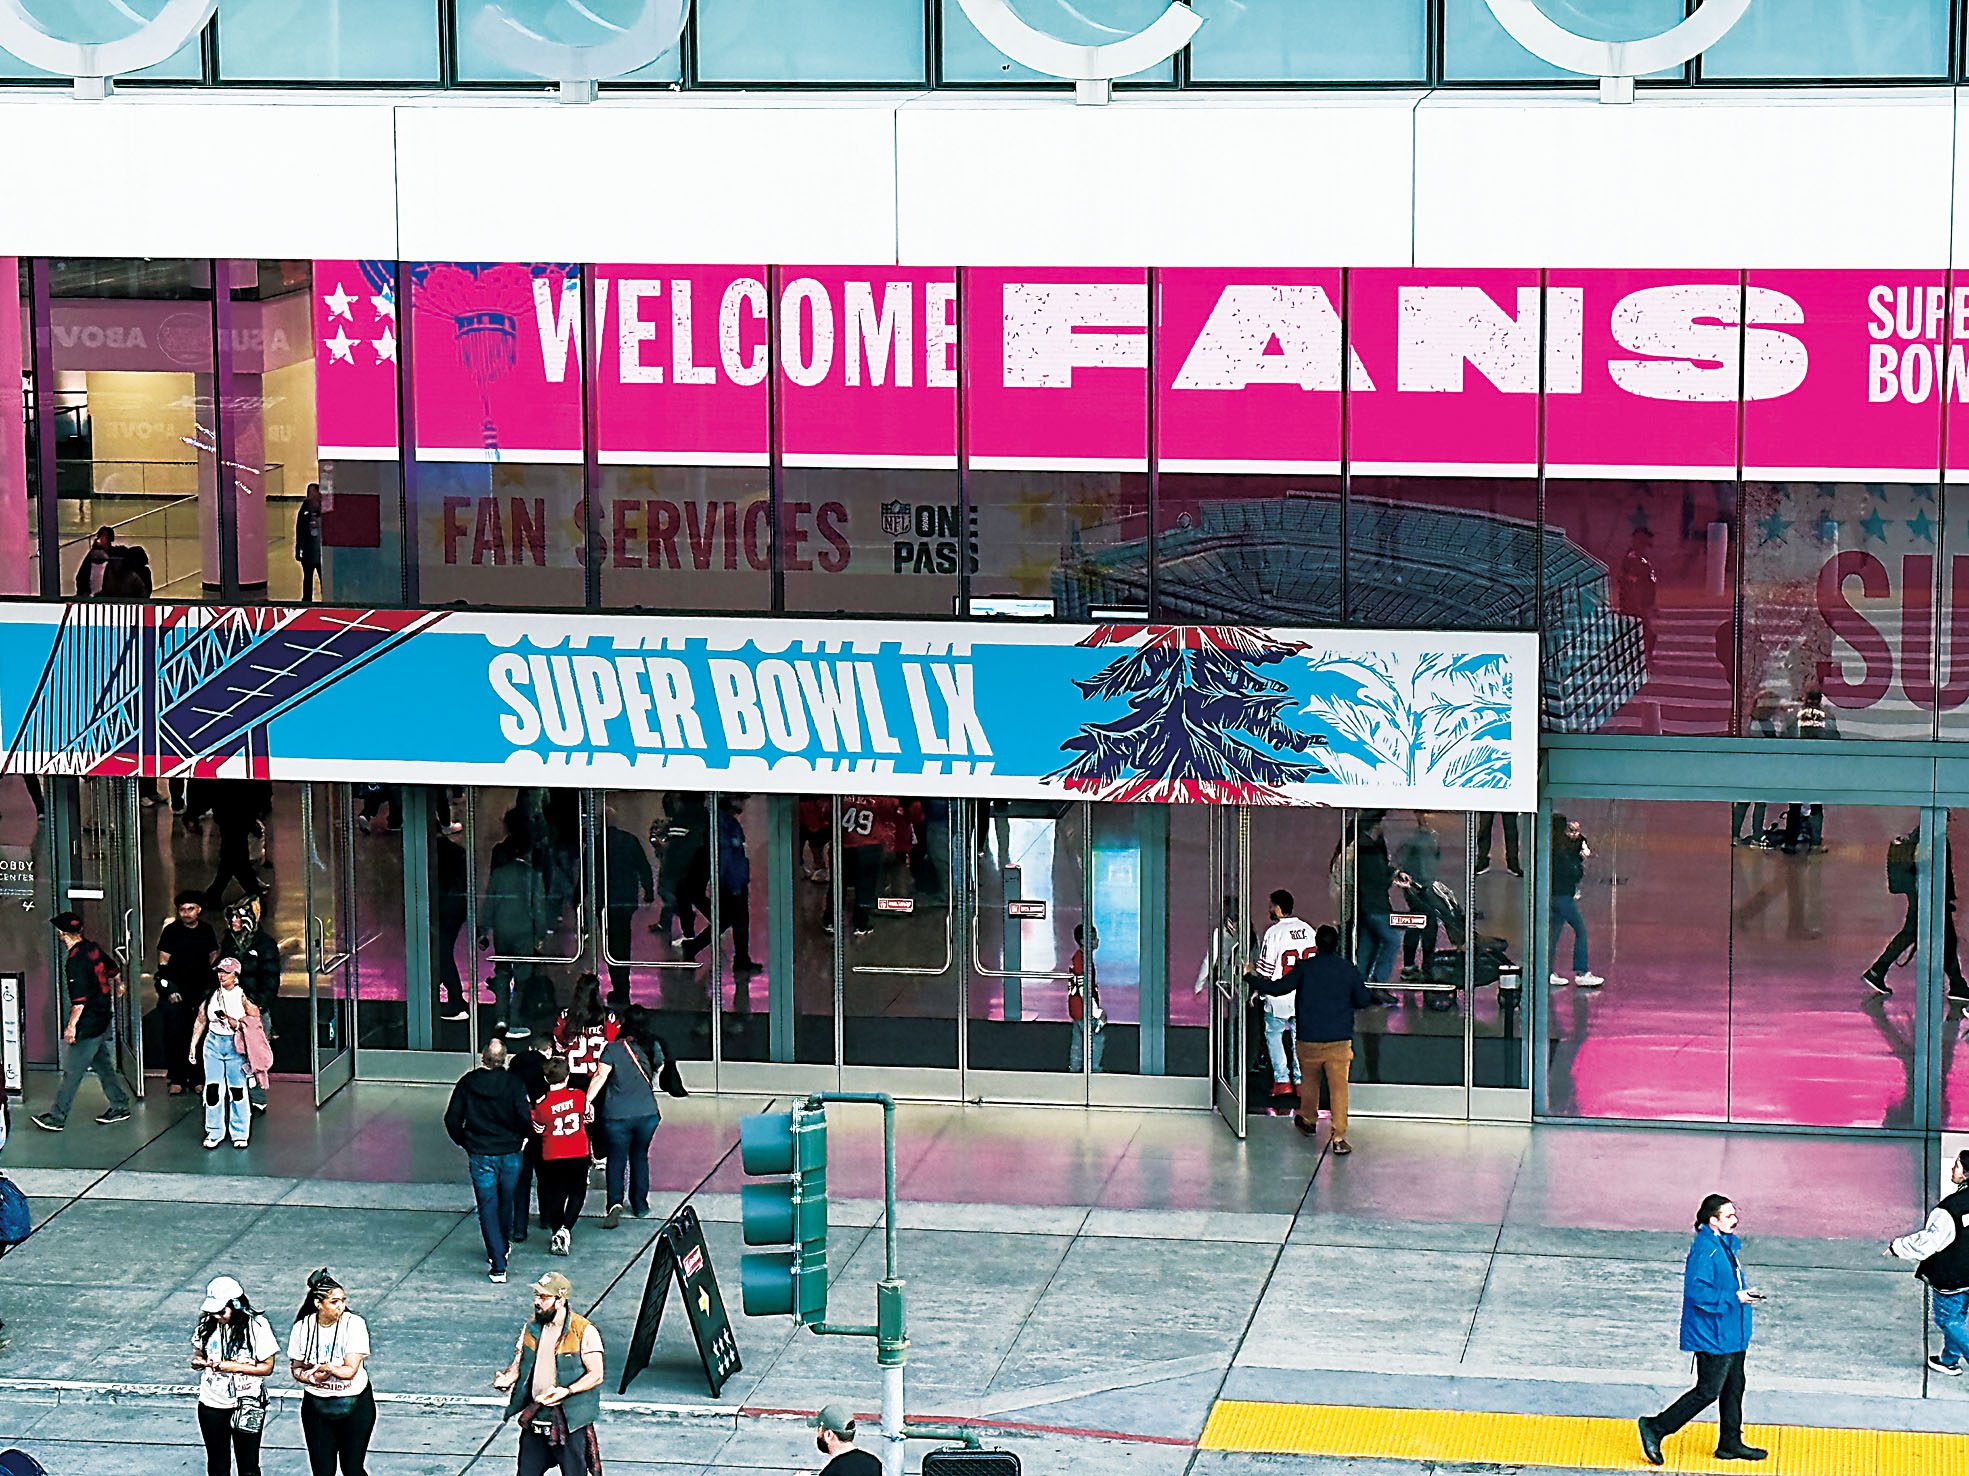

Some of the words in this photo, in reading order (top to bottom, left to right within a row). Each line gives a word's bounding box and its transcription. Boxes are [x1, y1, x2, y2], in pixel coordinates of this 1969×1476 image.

[532, 277, 958, 388] WELCOME
[1002, 284, 1808, 402] FANS
[1867, 285, 1969, 340] SUPE
[1868, 343, 1969, 404] BOW
[443, 496, 546, 567] FAN
[573, 499, 851, 573] SERVICES
[915, 505, 979, 537] ONE
[894, 541, 979, 574] PASS
[488, 652, 707, 749] SUPER
[708, 658, 901, 753] BOWL
[901, 662, 993, 756] LX
[841, 807, 874, 835] 49
[552, 1112, 580, 1136] 13
